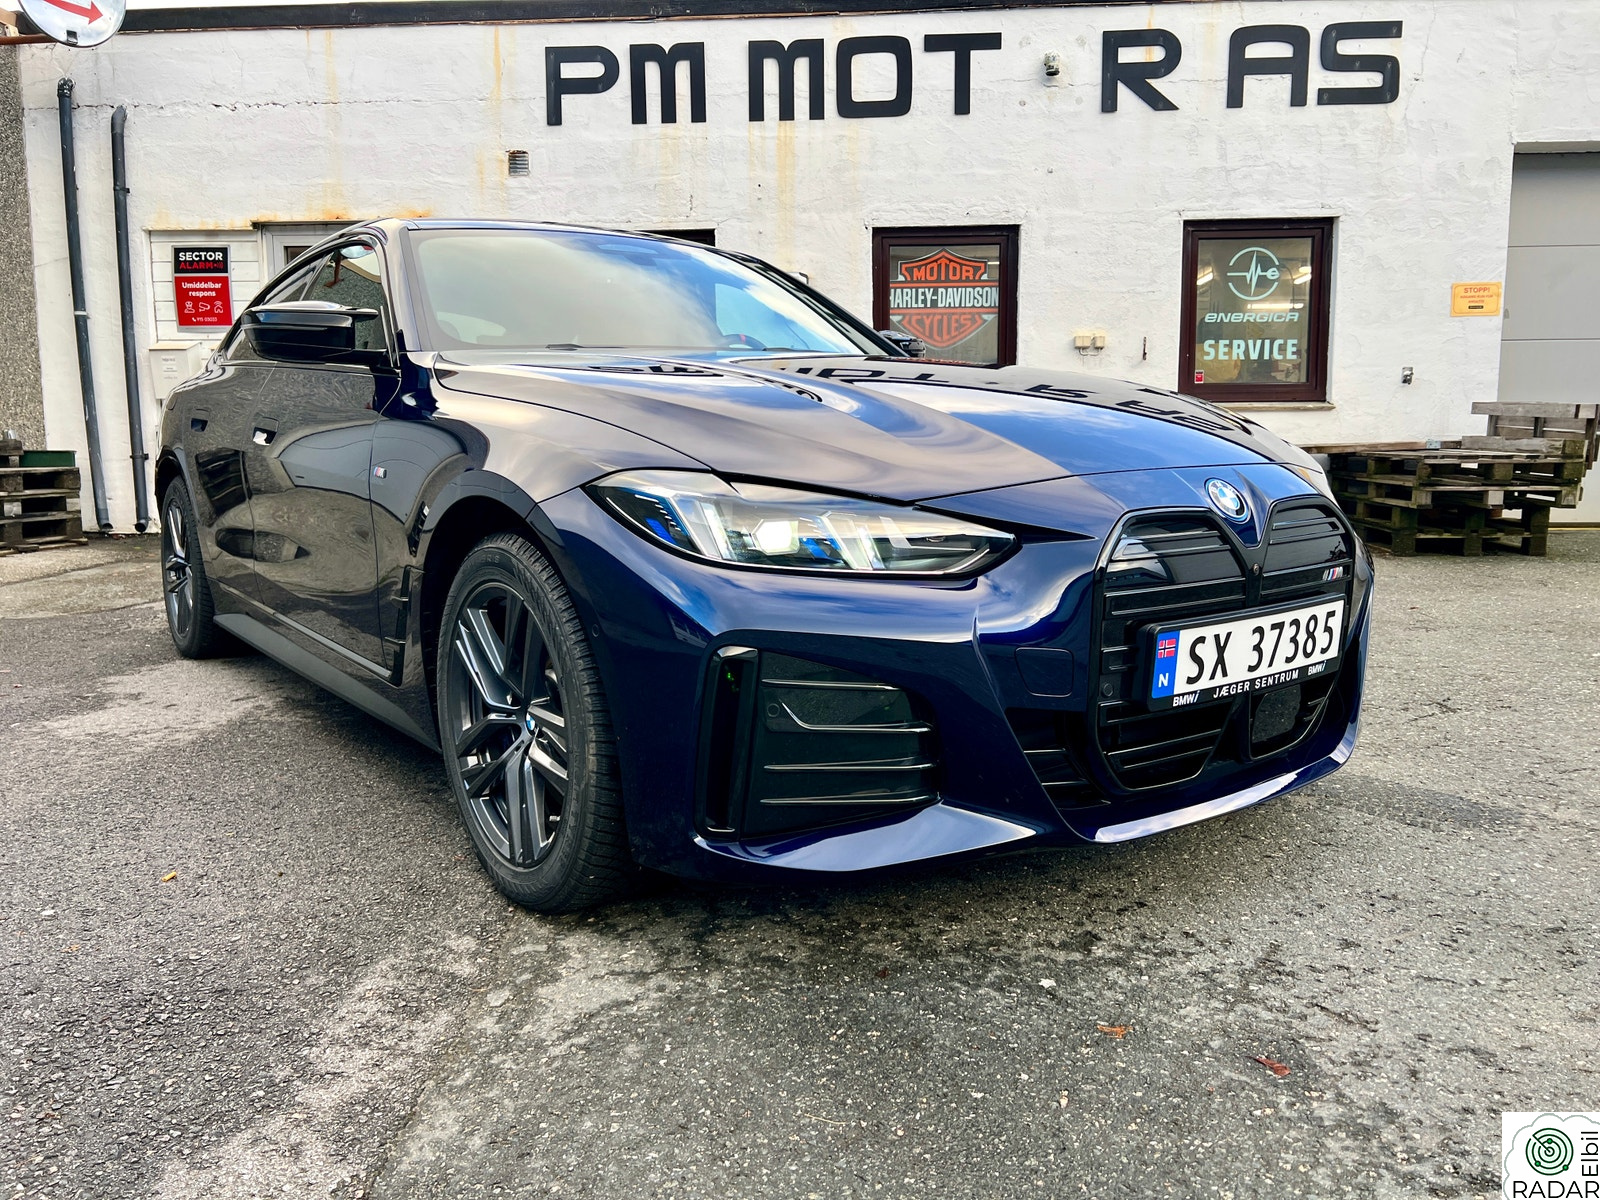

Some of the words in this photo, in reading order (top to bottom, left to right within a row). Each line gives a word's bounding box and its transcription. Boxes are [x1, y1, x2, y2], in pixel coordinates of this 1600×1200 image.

[545, 42, 706, 126] PM
[1226, 20, 1403, 108] AS
[179, 252, 223, 261] SECTOR
[913, 259, 974, 280] MOTOR
[911, 315, 972, 341] CYCLES
[1203, 339, 1298, 360] SERVICE
[1186, 631, 1233, 685] SX
[1247, 610, 1337, 673] 37385
[1158, 672, 1169, 688] N
[1213, 681, 1250, 699] JÆGER
[1255, 669, 1299, 689] SENTRUM
